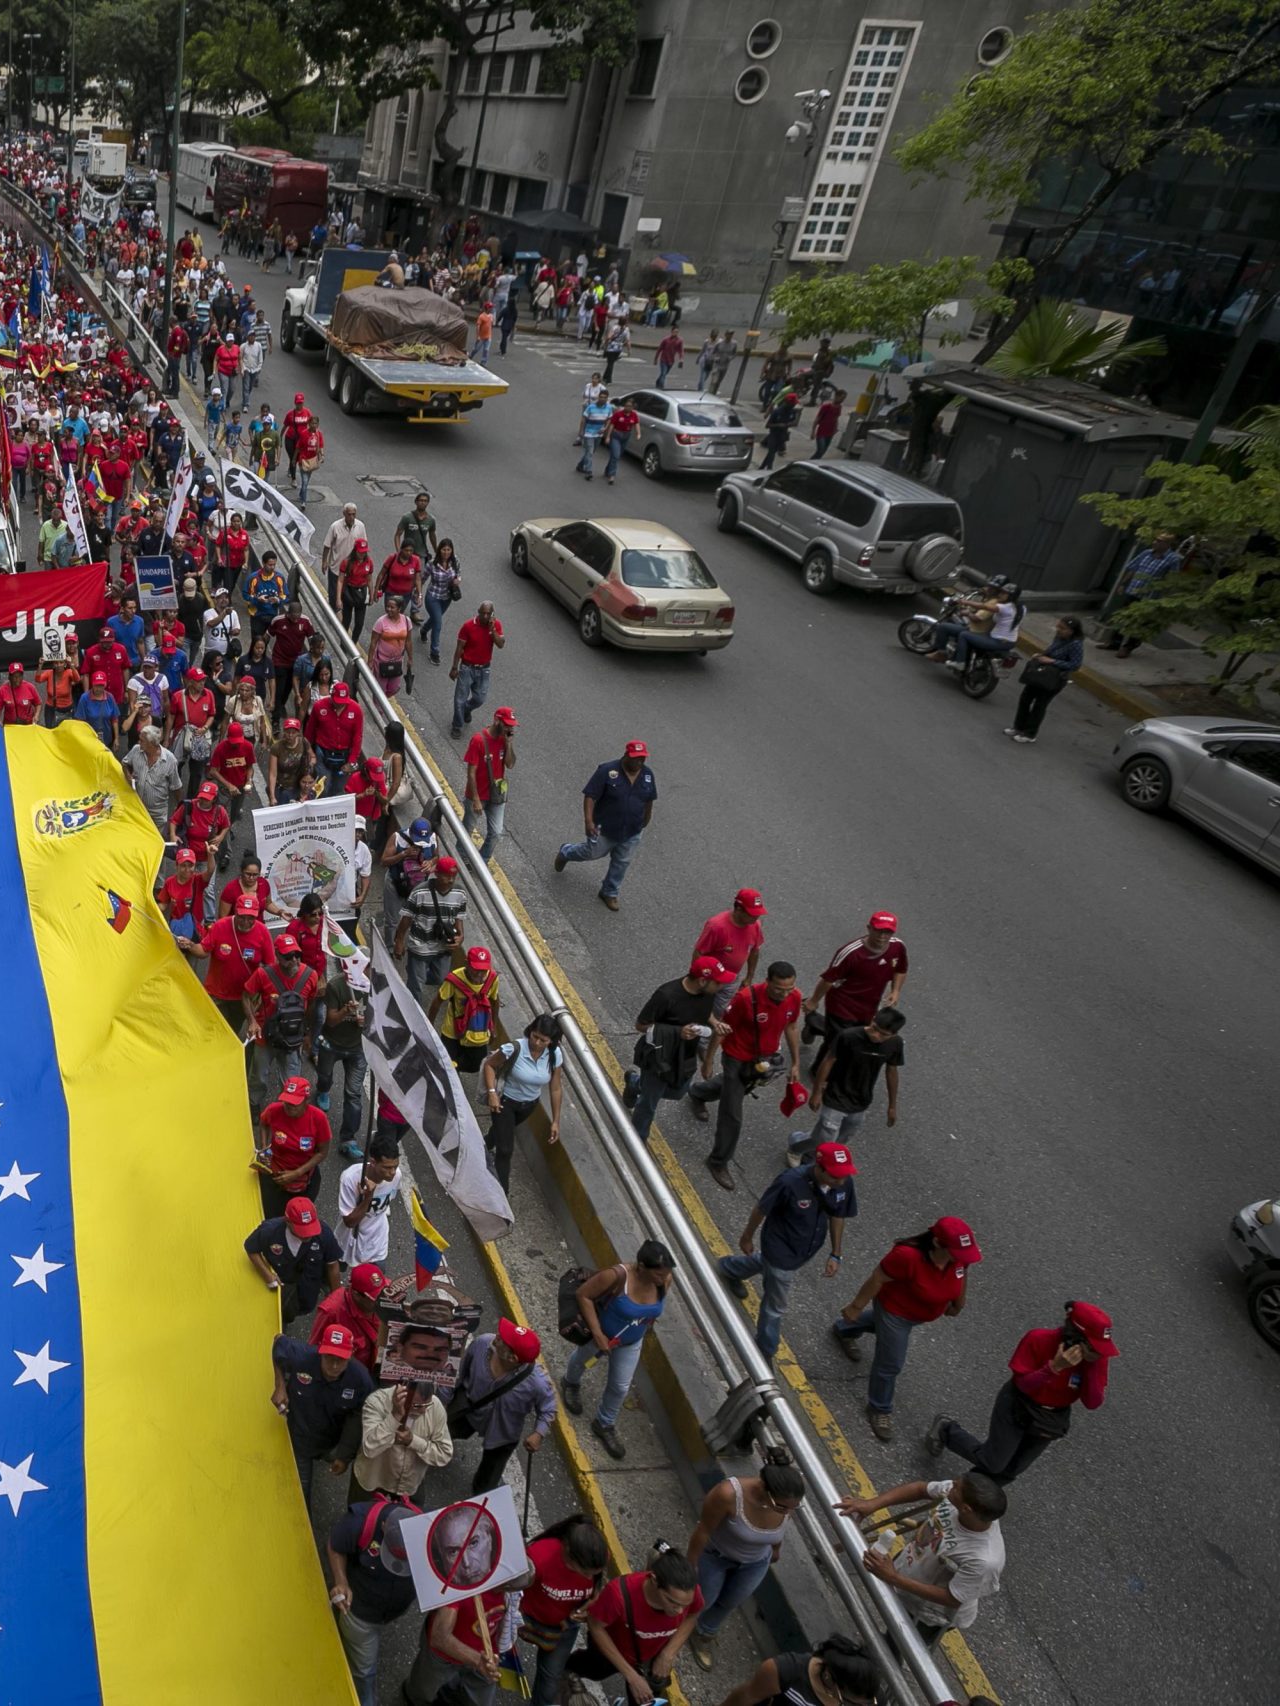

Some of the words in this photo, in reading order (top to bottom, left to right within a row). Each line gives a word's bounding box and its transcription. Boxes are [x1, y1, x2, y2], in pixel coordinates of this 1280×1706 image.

[263, 822, 284, 832] DERECHOS
[317, 814, 330, 822] TODAS
[334, 812, 348, 820] TODOS
[336, 845, 350, 865] CELAC
